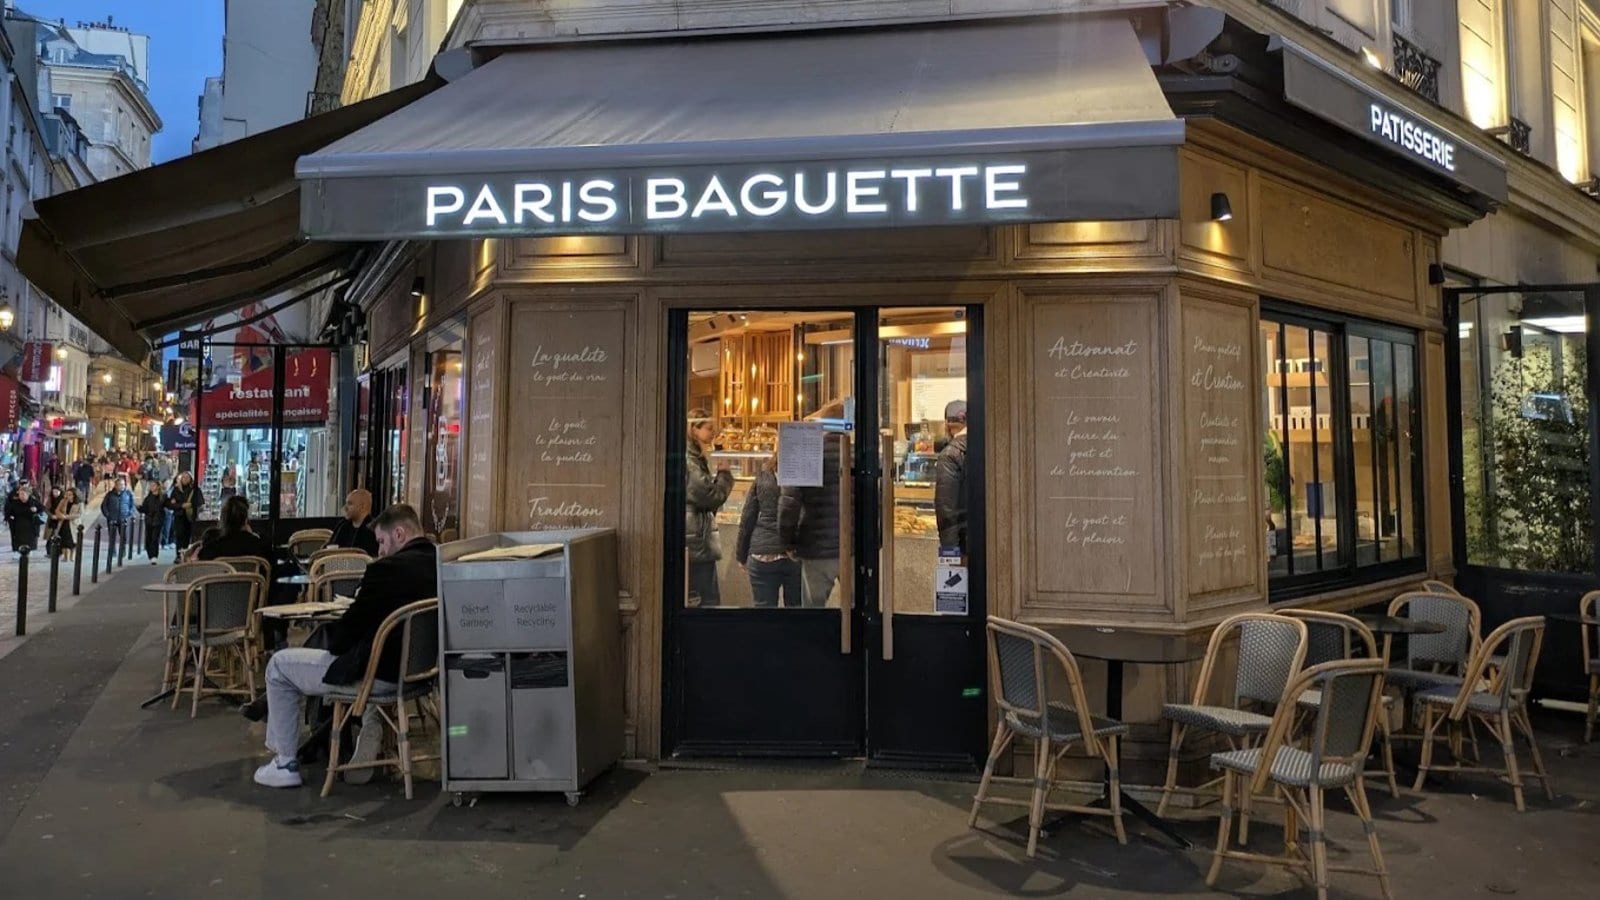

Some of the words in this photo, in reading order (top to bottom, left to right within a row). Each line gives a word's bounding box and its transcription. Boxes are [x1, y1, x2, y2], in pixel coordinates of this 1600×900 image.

[1370, 103, 1456, 172] PATISSERIE
[426, 180, 618, 226] PARIS
[646, 164, 1029, 220] BAGUETTE
[1047, 336, 1138, 360] Artisanat
[531, 345, 552, 367] La
[533, 371, 544, 381] le
[1055, 367, 1069, 378] et
[229, 384, 311, 400] restauant
[548, 417, 561, 431] Le
[1067, 410, 1081, 425] Le
[536, 434, 546, 445] le
[547, 435, 582, 448] plaisir
[584, 435, 597, 445] et
[541, 451, 553, 462] la
[1099, 448, 1112, 457] et
[1050, 465, 1065, 476] de
[529, 497, 604, 518] Tradition
[1065, 512, 1080, 527] Le
[1112, 515, 1127, 525] et
[1066, 531, 1080, 543] le
[1082, 532, 1125, 547] plaisir
[514, 602, 557, 616] Recyclable
[460, 618, 494, 630] Garbage
[517, 617, 556, 630] Recycling
